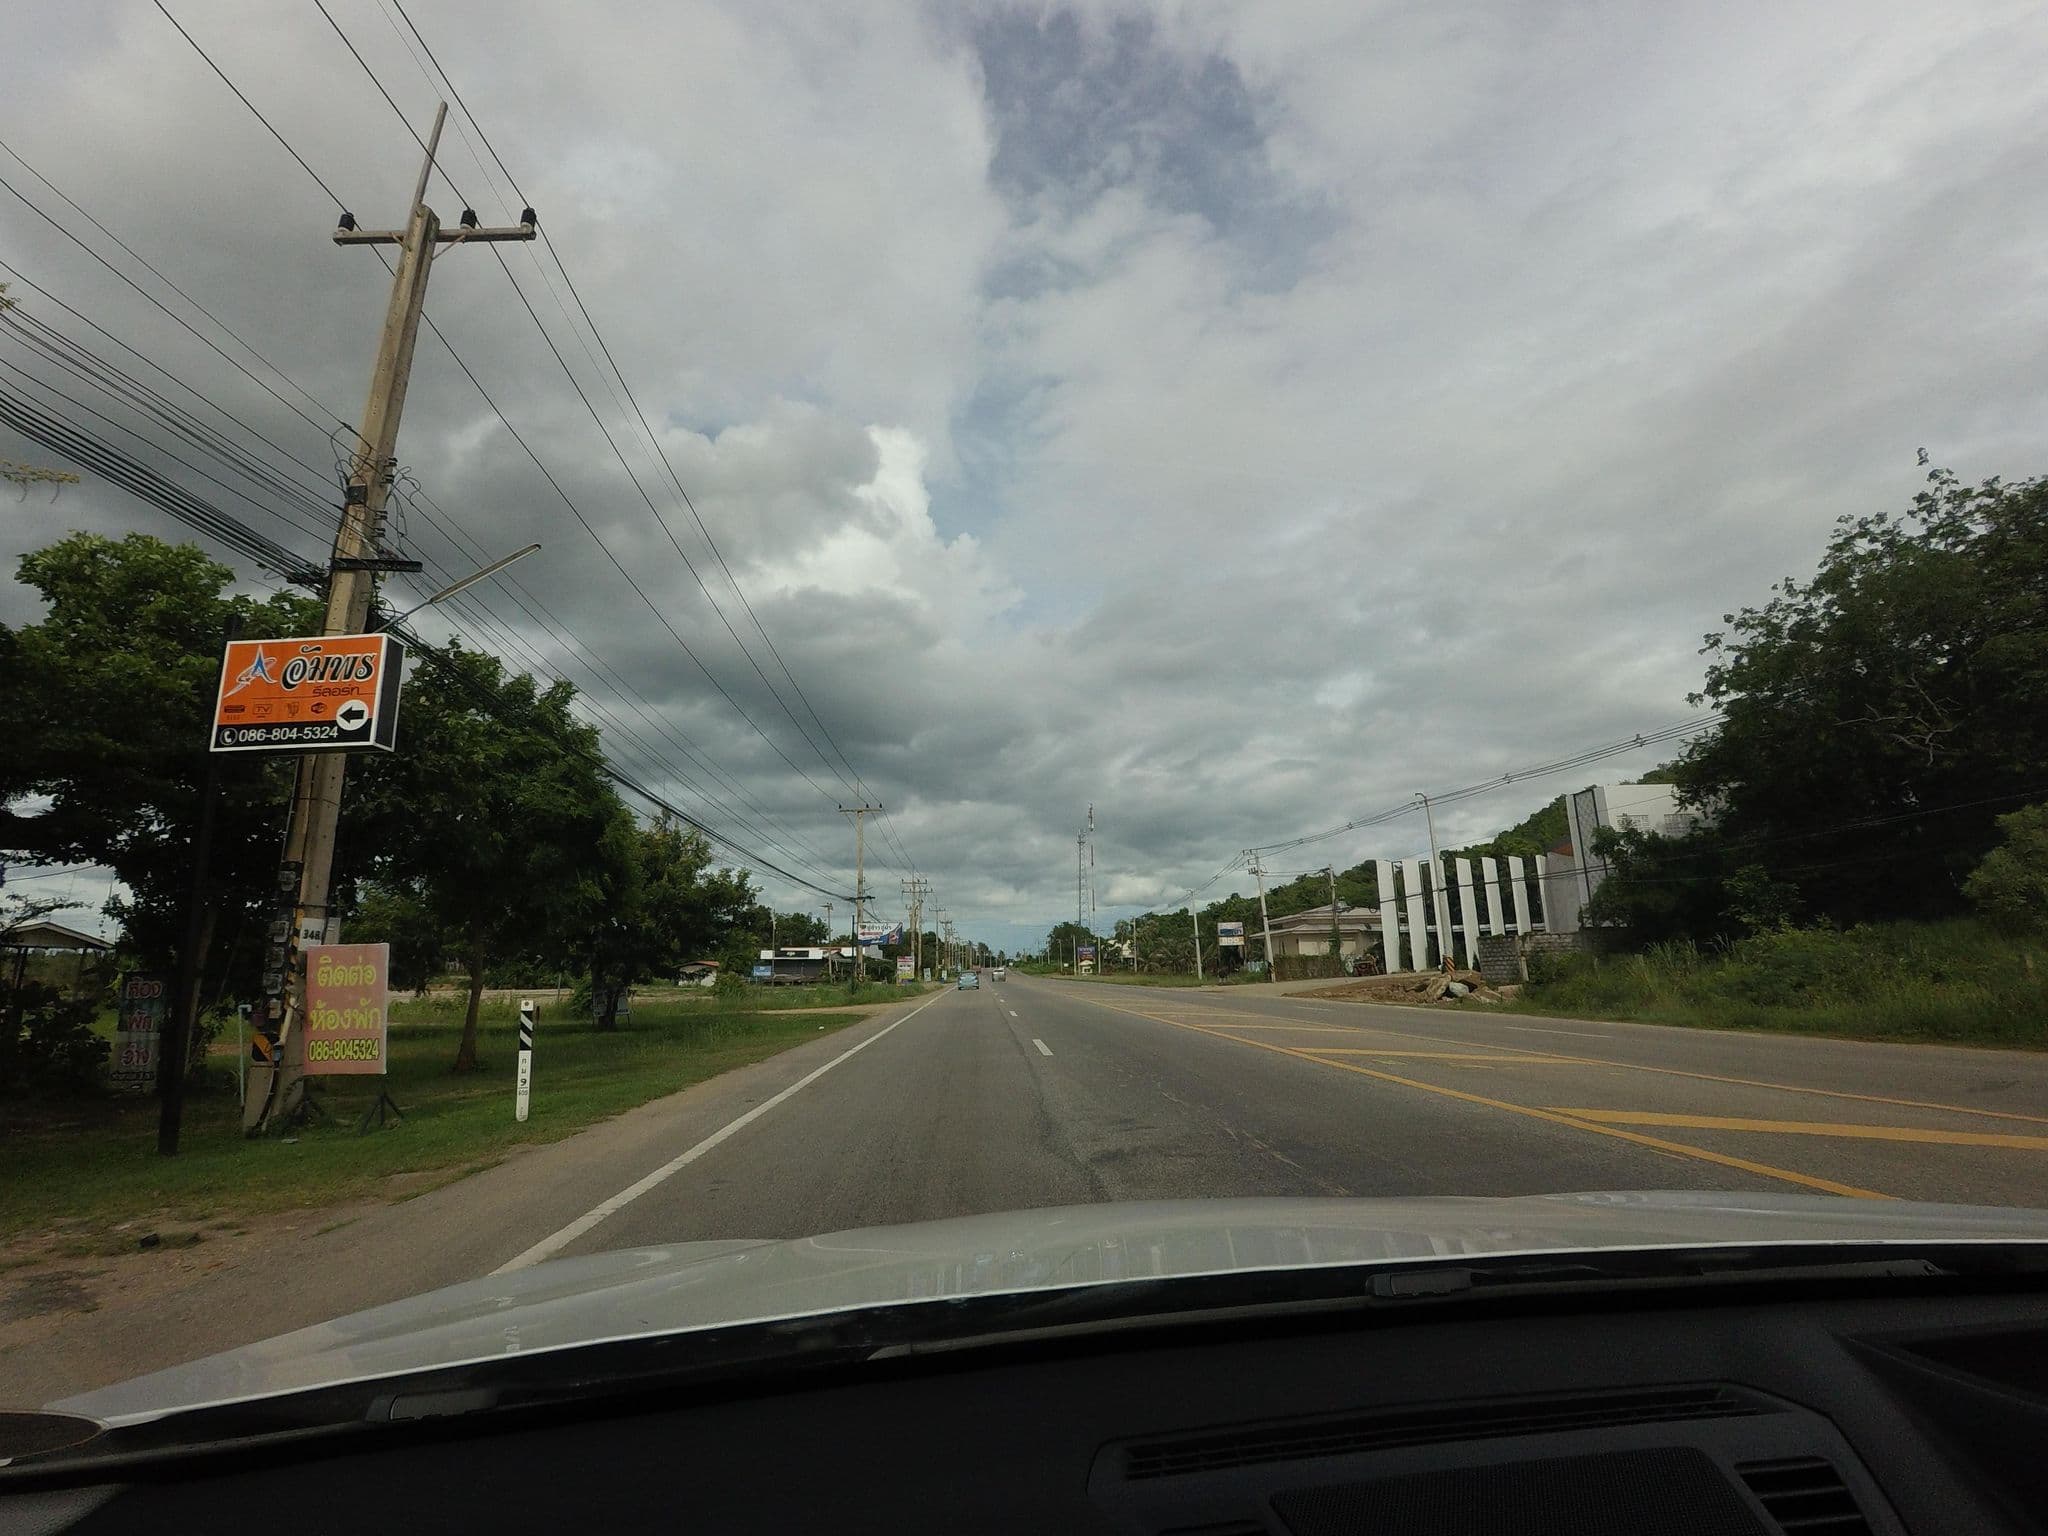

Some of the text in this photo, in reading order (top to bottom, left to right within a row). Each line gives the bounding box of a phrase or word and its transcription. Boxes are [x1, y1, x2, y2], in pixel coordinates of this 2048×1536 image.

[281, 645, 377, 691] อัมพร
[238, 726, 339, 742] 086-804-5324
[317, 955, 377, 988] ติดต่อ
[309, 998, 382, 1031] ห้องพัก
[309, 1038, 380, 1061] 086-8045324
